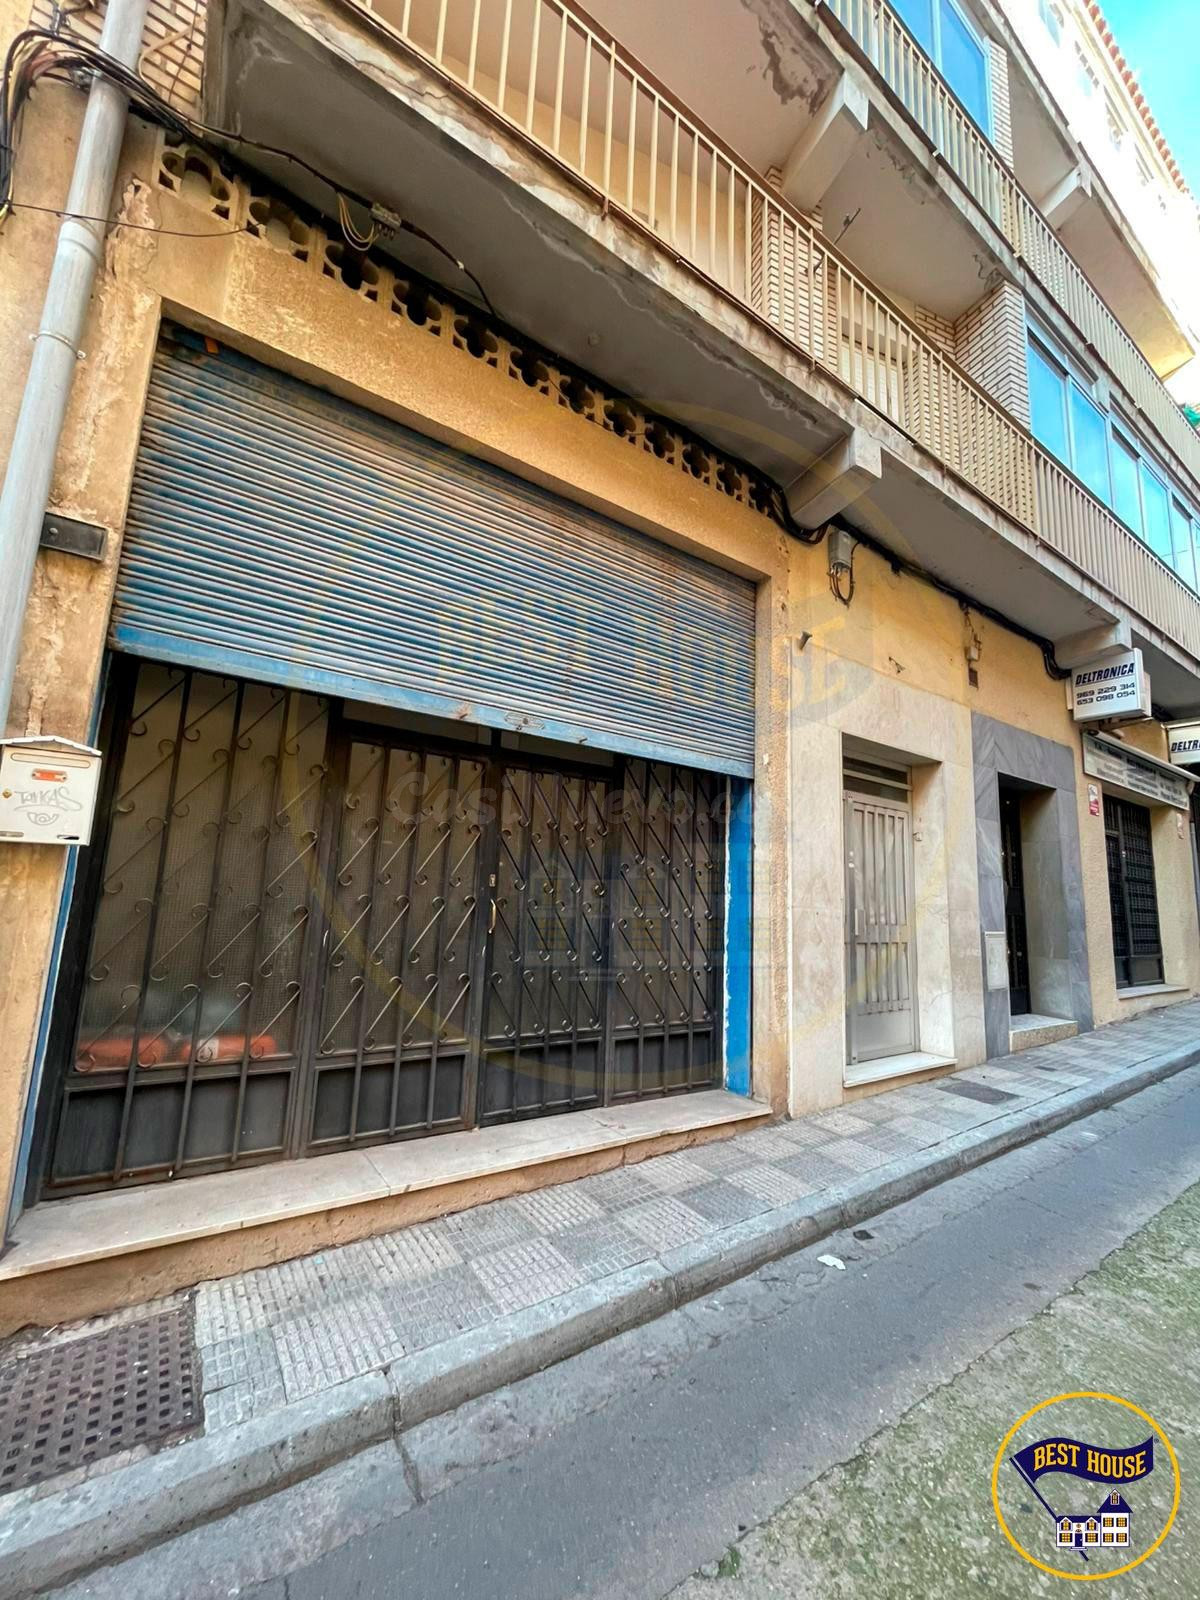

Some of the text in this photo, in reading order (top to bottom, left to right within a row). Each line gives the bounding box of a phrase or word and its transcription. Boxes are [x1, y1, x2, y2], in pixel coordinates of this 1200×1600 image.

[1075, 662, 1135, 686] DELTRONICA
[1076, 682, 1136, 699] 969 229 314
[1076, 690, 1136, 706] 653 098 054
[1171, 739, 1200, 752] DELTR
